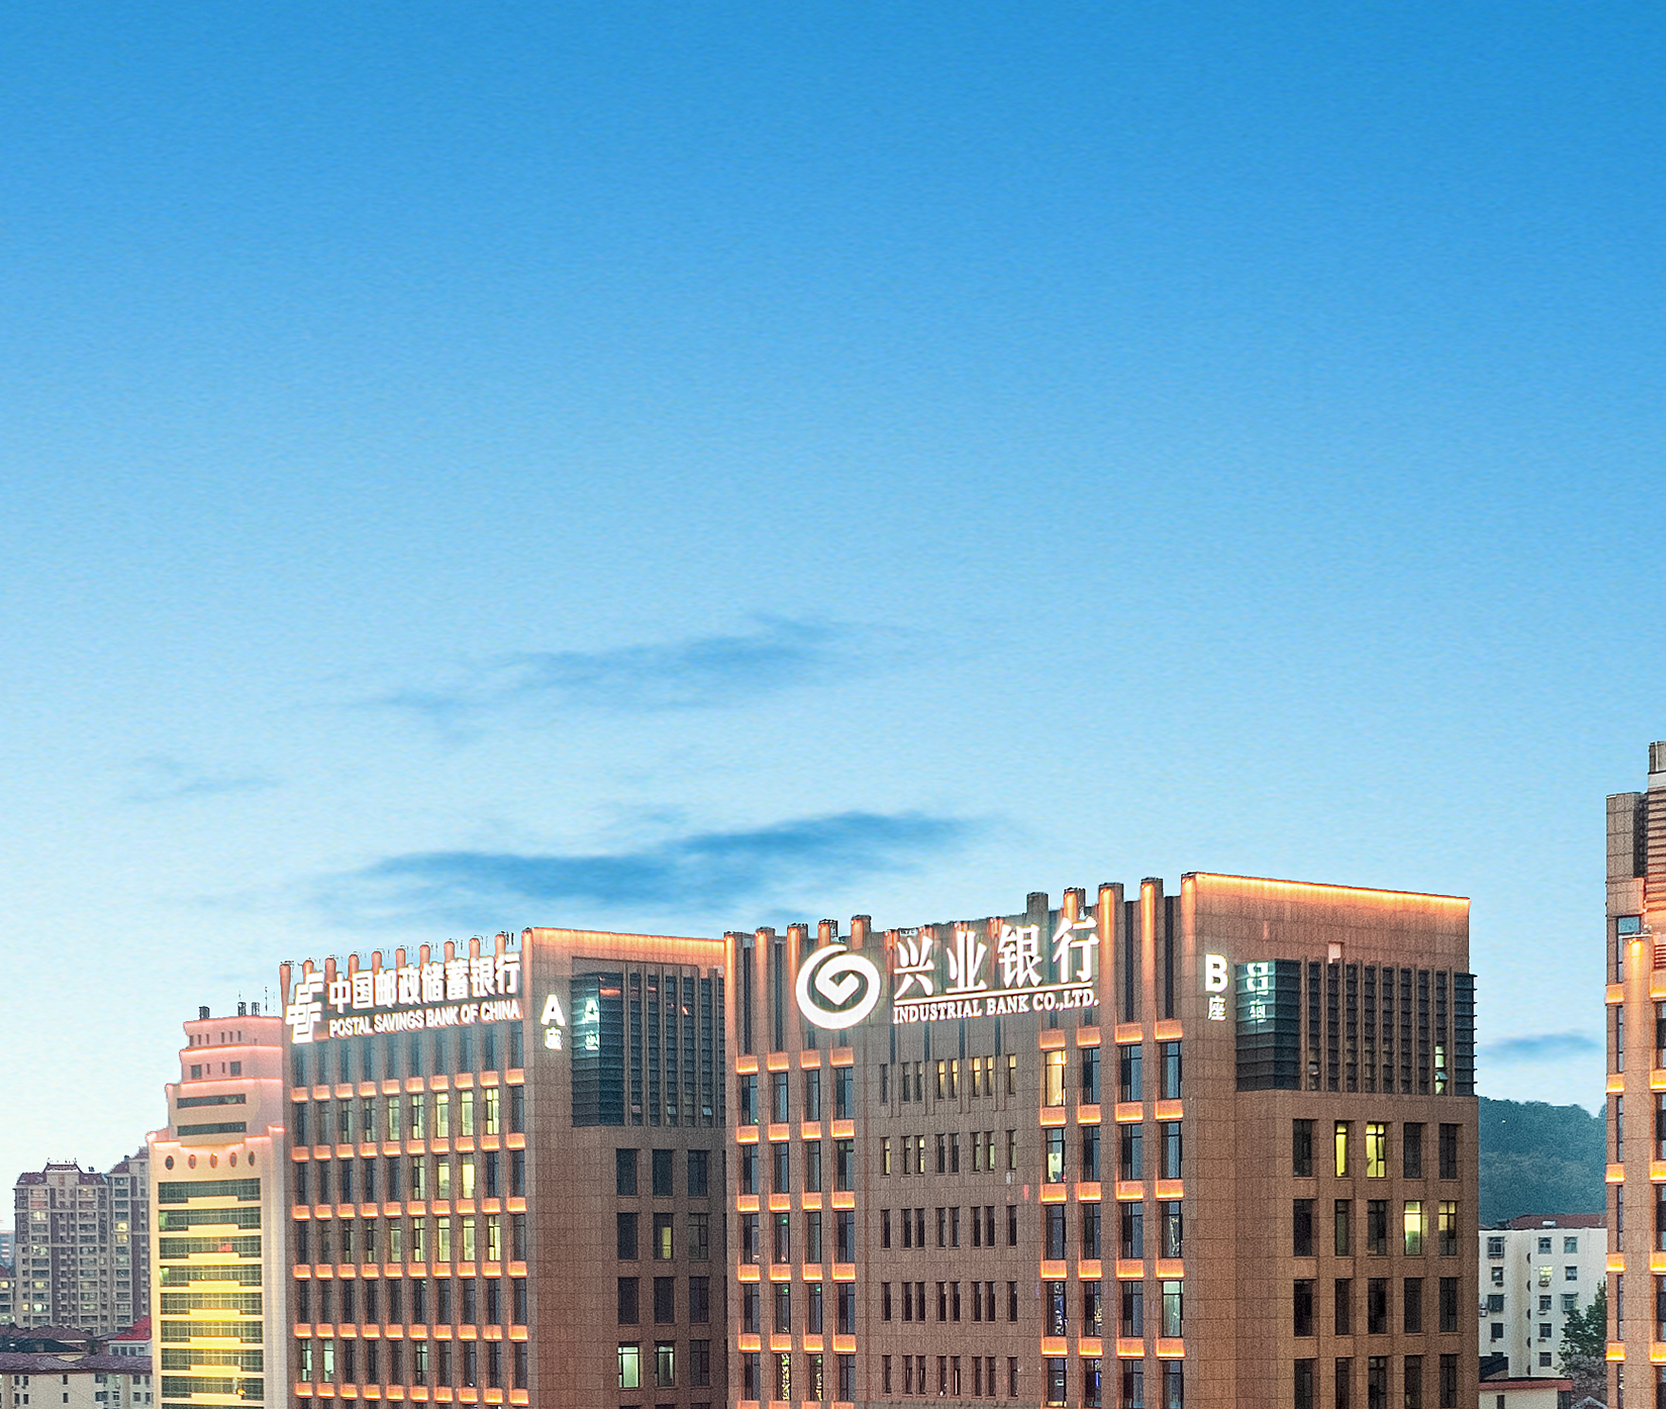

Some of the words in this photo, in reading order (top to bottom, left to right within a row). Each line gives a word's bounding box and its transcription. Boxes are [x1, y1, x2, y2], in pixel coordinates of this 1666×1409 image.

[328, 951, 521, 1014] 中国邮政储蓄银行
[894, 915, 1100, 1001] 兴业银行
[329, 1016, 374, 1038] POSTAL
[376, 1010, 424, 1033] SAVINGS
[426, 1006, 459, 1028] BANK
[460, 1003, 479, 1024] OF
[480, 999, 521, 1022] CHINA
[893, 999, 982, 1025] INDUSTRIAL
[986, 997, 1030, 1016] BANK
